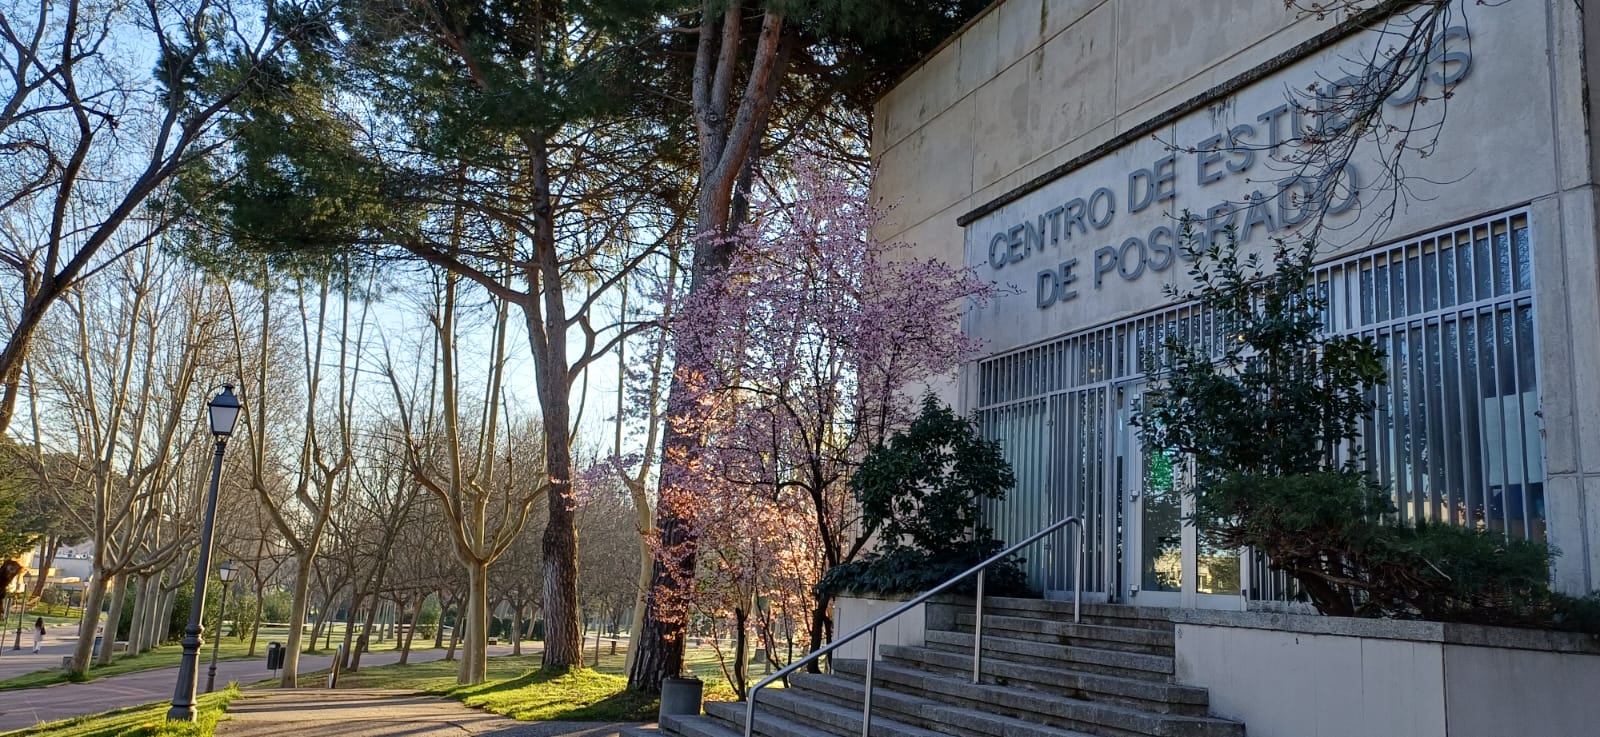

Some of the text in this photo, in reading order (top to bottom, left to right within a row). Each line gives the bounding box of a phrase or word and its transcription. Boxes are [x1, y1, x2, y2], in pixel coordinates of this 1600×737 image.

[988, 187, 1115, 269] CENTRO
[1128, 154, 1176, 213] DE
[1036, 162, 1359, 309] DE POSGRADO
